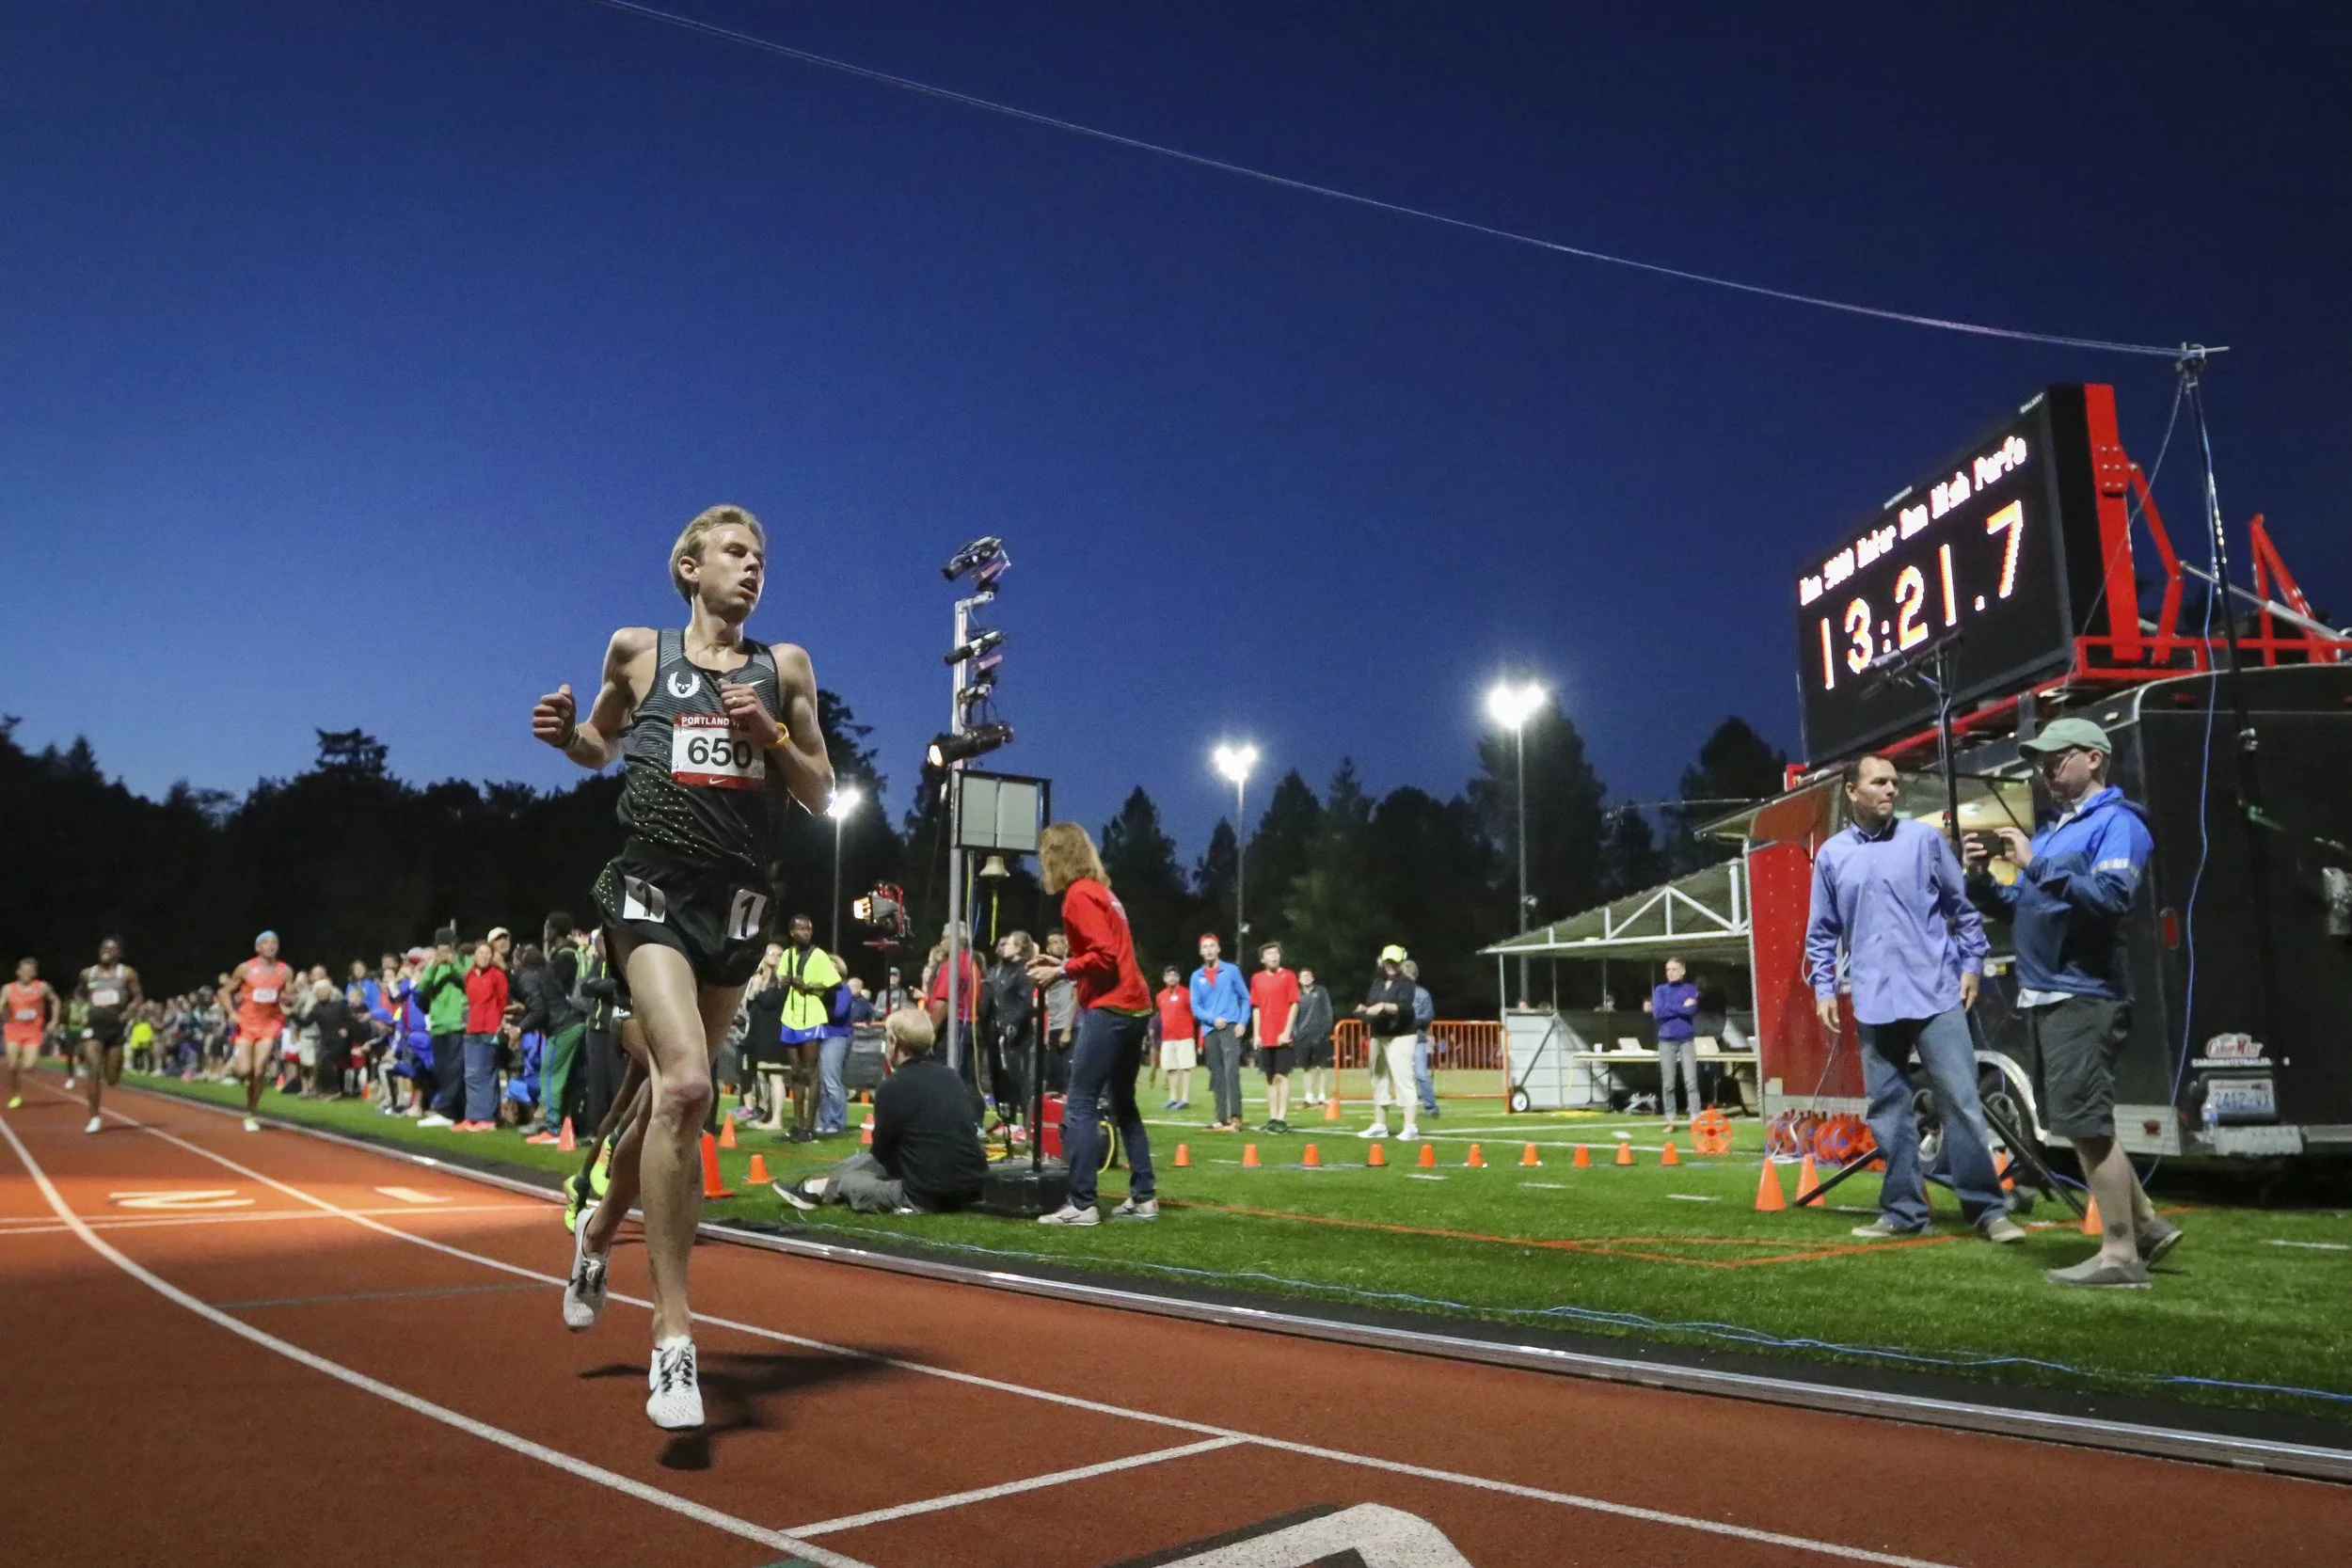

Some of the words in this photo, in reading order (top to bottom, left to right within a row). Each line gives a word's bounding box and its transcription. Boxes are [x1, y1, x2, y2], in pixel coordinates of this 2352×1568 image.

[1820, 499, 2024, 689] 13:21.7
[681, 716, 730, 726] PORTLAND
[688, 736, 753, 768] 650
[740, 895, 756, 938] 1
